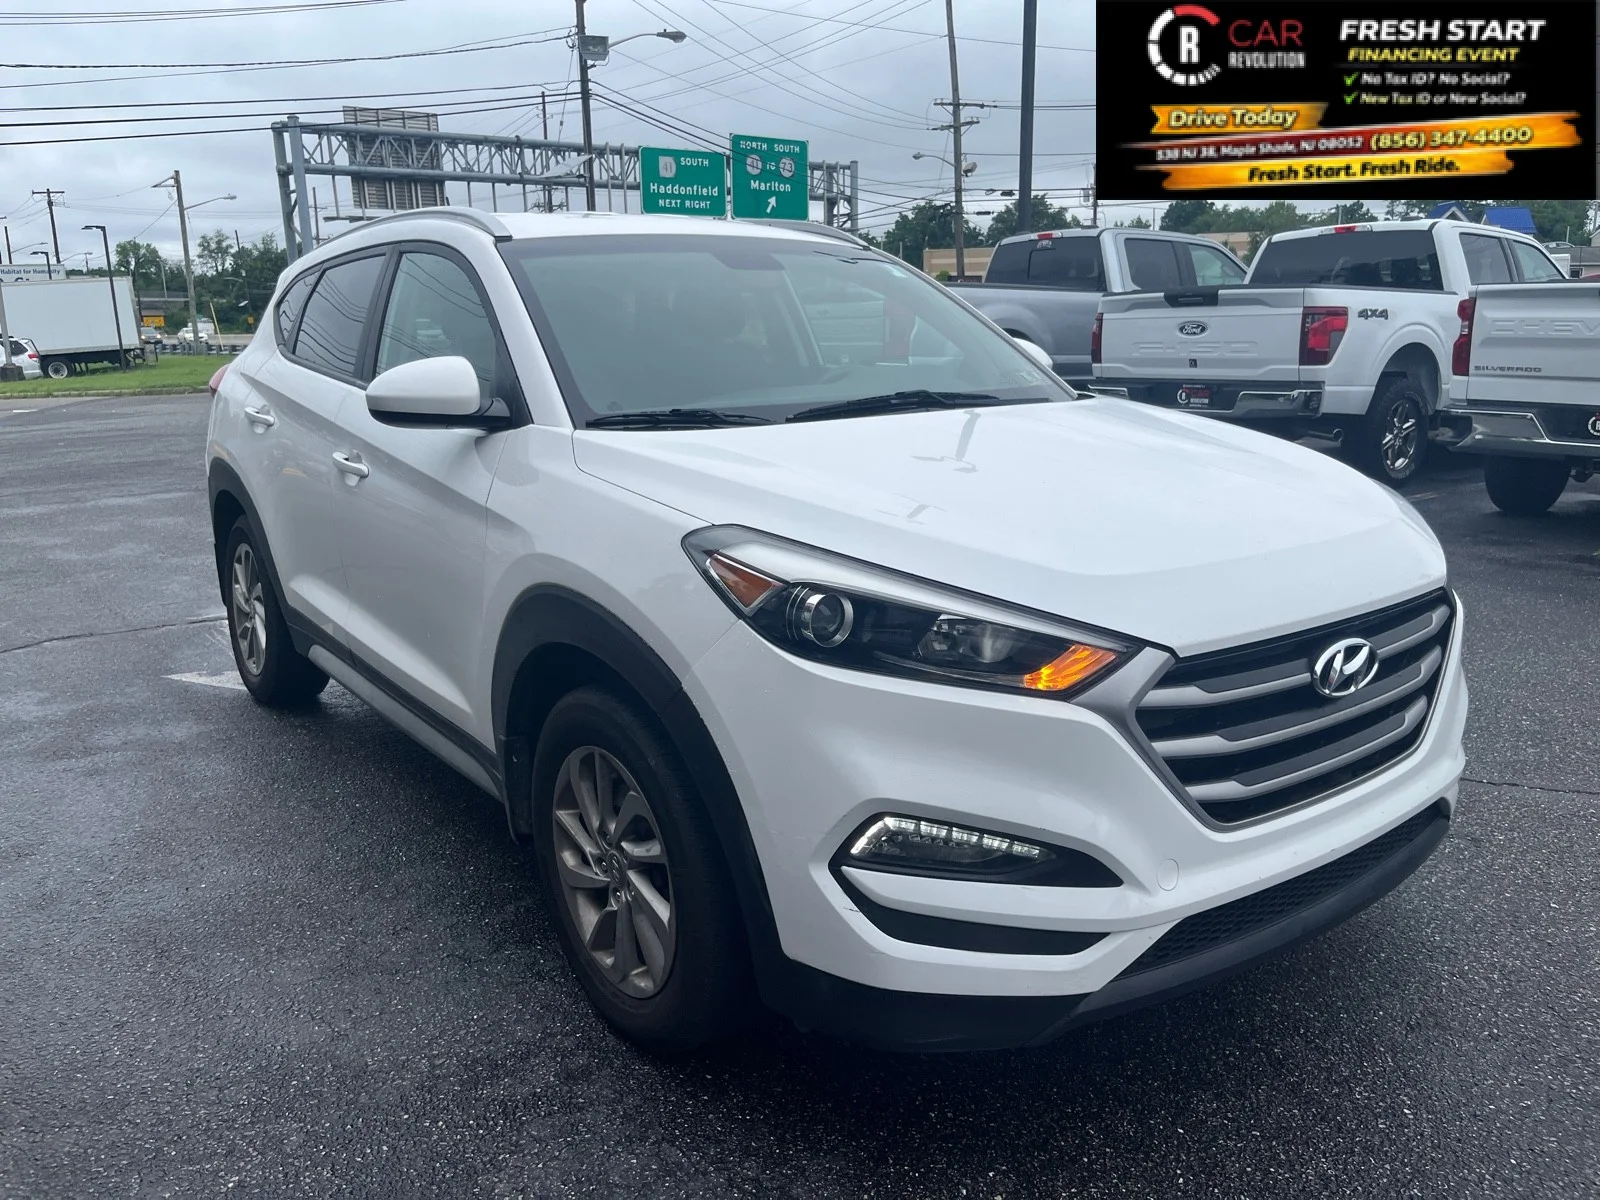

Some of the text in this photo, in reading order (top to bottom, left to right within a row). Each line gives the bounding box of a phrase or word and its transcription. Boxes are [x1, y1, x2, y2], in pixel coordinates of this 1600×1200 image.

[740, 140, 800, 154] NORTH SOUTH
[662, 161, 673, 174] 41
[680, 157, 709, 167] SOUTH
[780, 162, 793, 172] 73
[650, 183, 719, 197] Haddonfield
[750, 179, 791, 192] Marlton
[658, 199, 711, 210] NEXT RIGHT
[1182, 323, 1202, 334] Ford
[1474, 364, 1542, 373] SILVERADO
